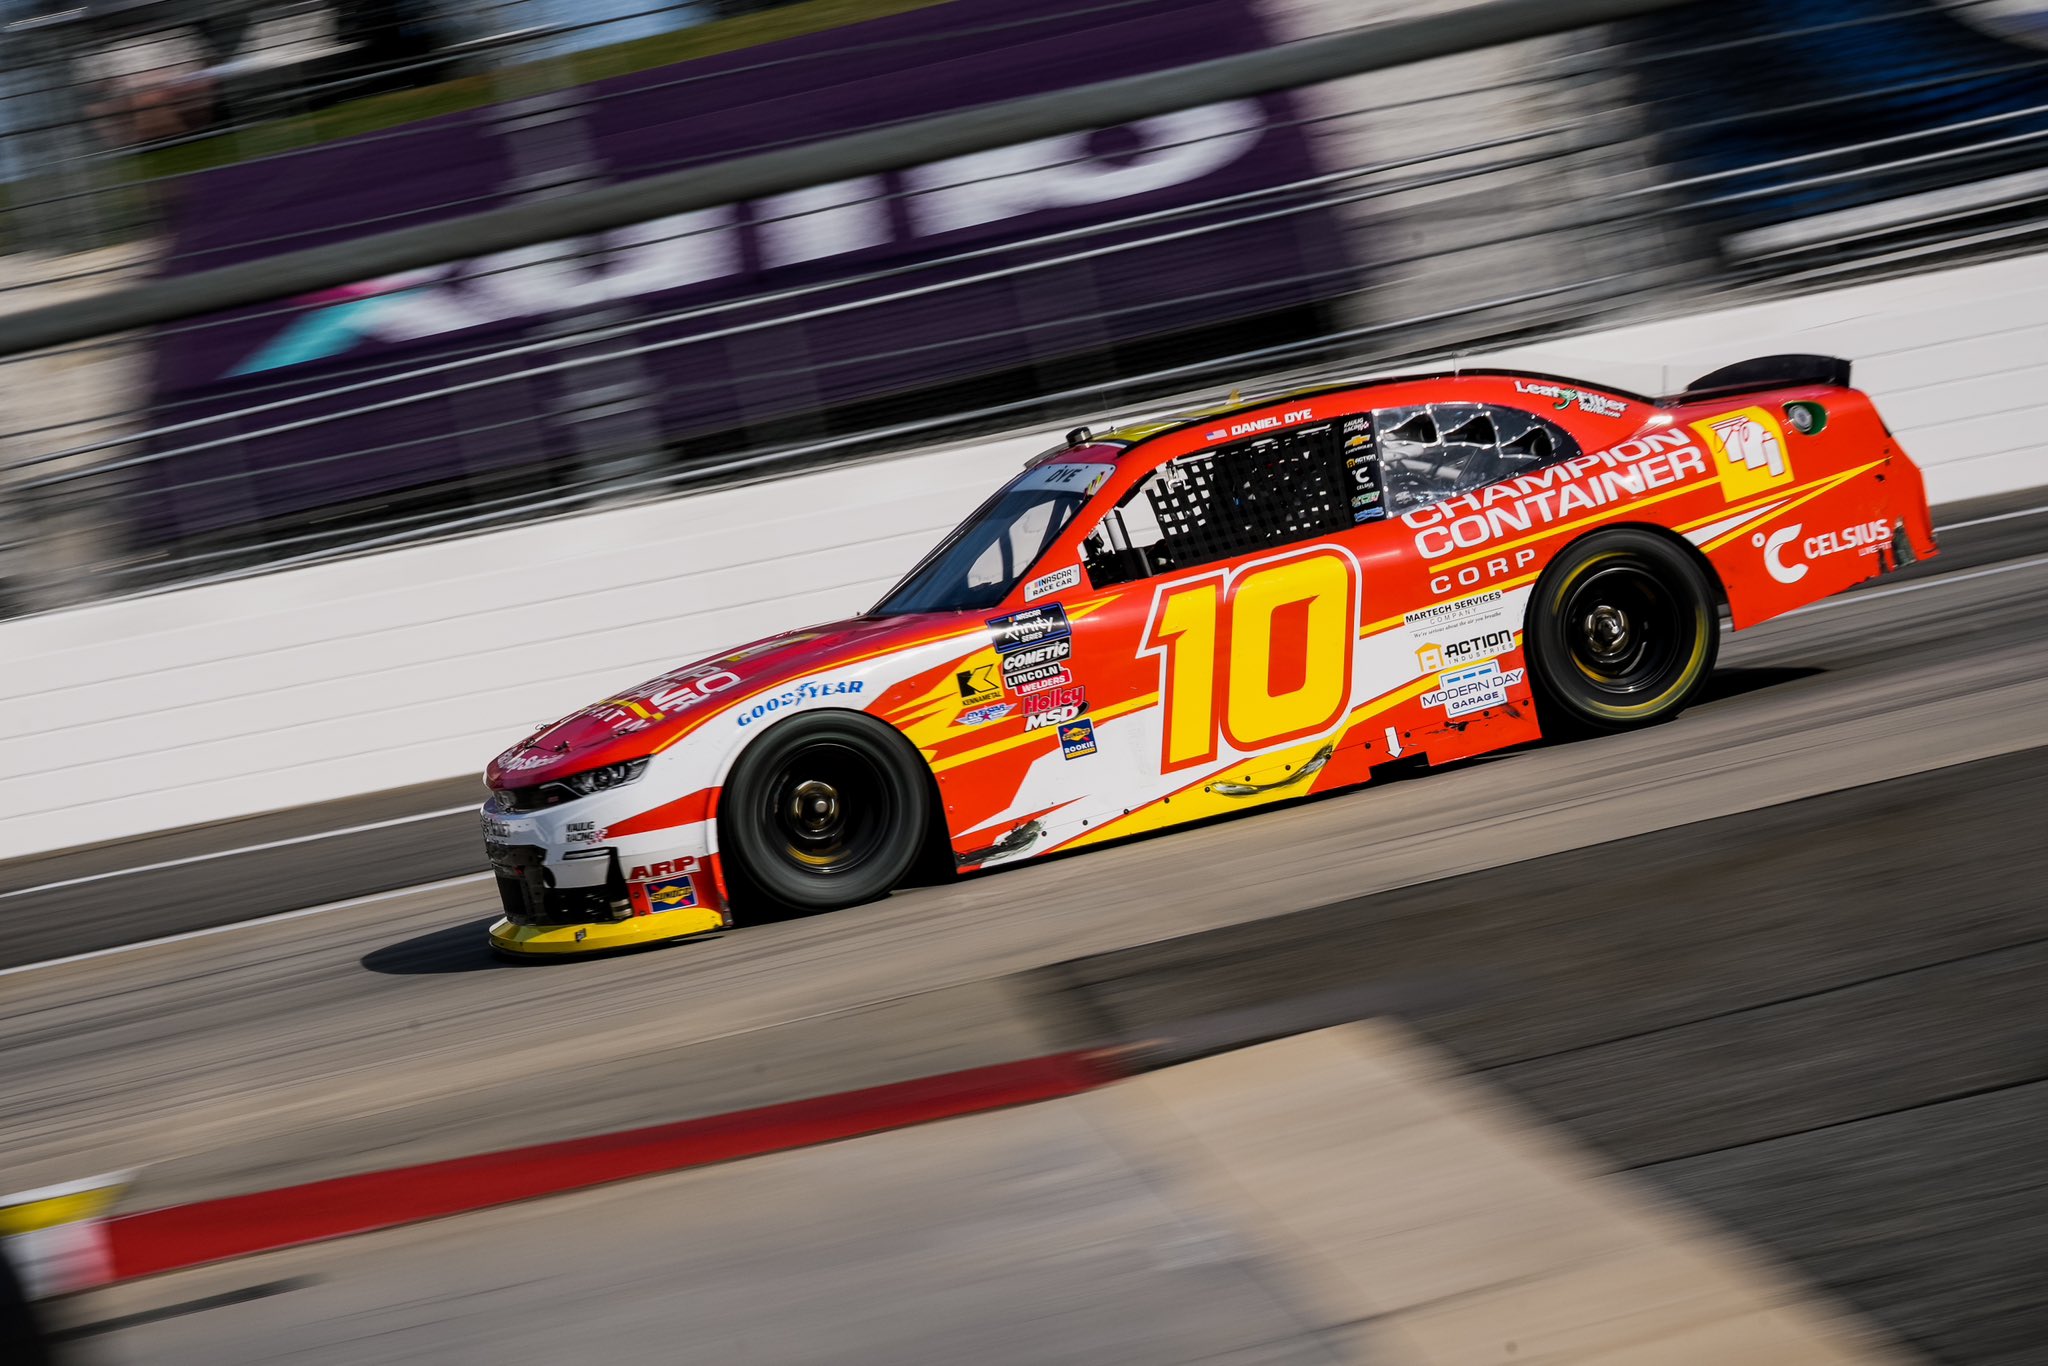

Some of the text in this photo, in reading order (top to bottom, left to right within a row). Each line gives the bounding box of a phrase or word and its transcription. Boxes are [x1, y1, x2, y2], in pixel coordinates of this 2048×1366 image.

[1231, 408, 1312, 436] DANIEL DYE
[1045, 469, 1083, 482] DYE
[1400, 428, 1692, 530] CHAMPION
[1414, 447, 1706, 559] CONTAINER
[1803, 518, 1892, 560] CELSIUS
[1041, 569, 1072, 586] NASCAR
[1430, 549, 1535, 594] CORP
[1033, 578, 1072, 596] RACE CAR
[1016, 609, 1042, 620] NASCAR
[1406, 591, 1502, 622] MARTECH SERVICES
[1430, 608, 1477, 624] COMPANY
[1445, 623, 1458, 631] about
[1475, 616, 1484, 624] you
[1484, 611, 1502, 620] breathe
[1021, 631, 1043, 643] SERIES
[1444, 630, 1512, 658] ACTION
[1003, 642, 1069, 670] COMETIC
[1144, 547, 1356, 772] 10
[1449, 643, 1514, 664] INDUSTRIES
[1007, 665, 1059, 686] LINCOLN
[1021, 675, 1066, 693] WELDERS
[962, 691, 1002, 706] KENNAMETAL
[1423, 670, 1523, 706] MODERN DAY
[736, 680, 864, 728] GOODYEAR
[1023, 686, 1085, 716] Holley
[1452, 691, 1500, 710] GARAGE
[1024, 706, 1080, 732] MSD
[1064, 741, 1095, 754] ROOKIE
[630, 856, 695, 880] ARP
[651, 886, 693, 902] SUNOCO
